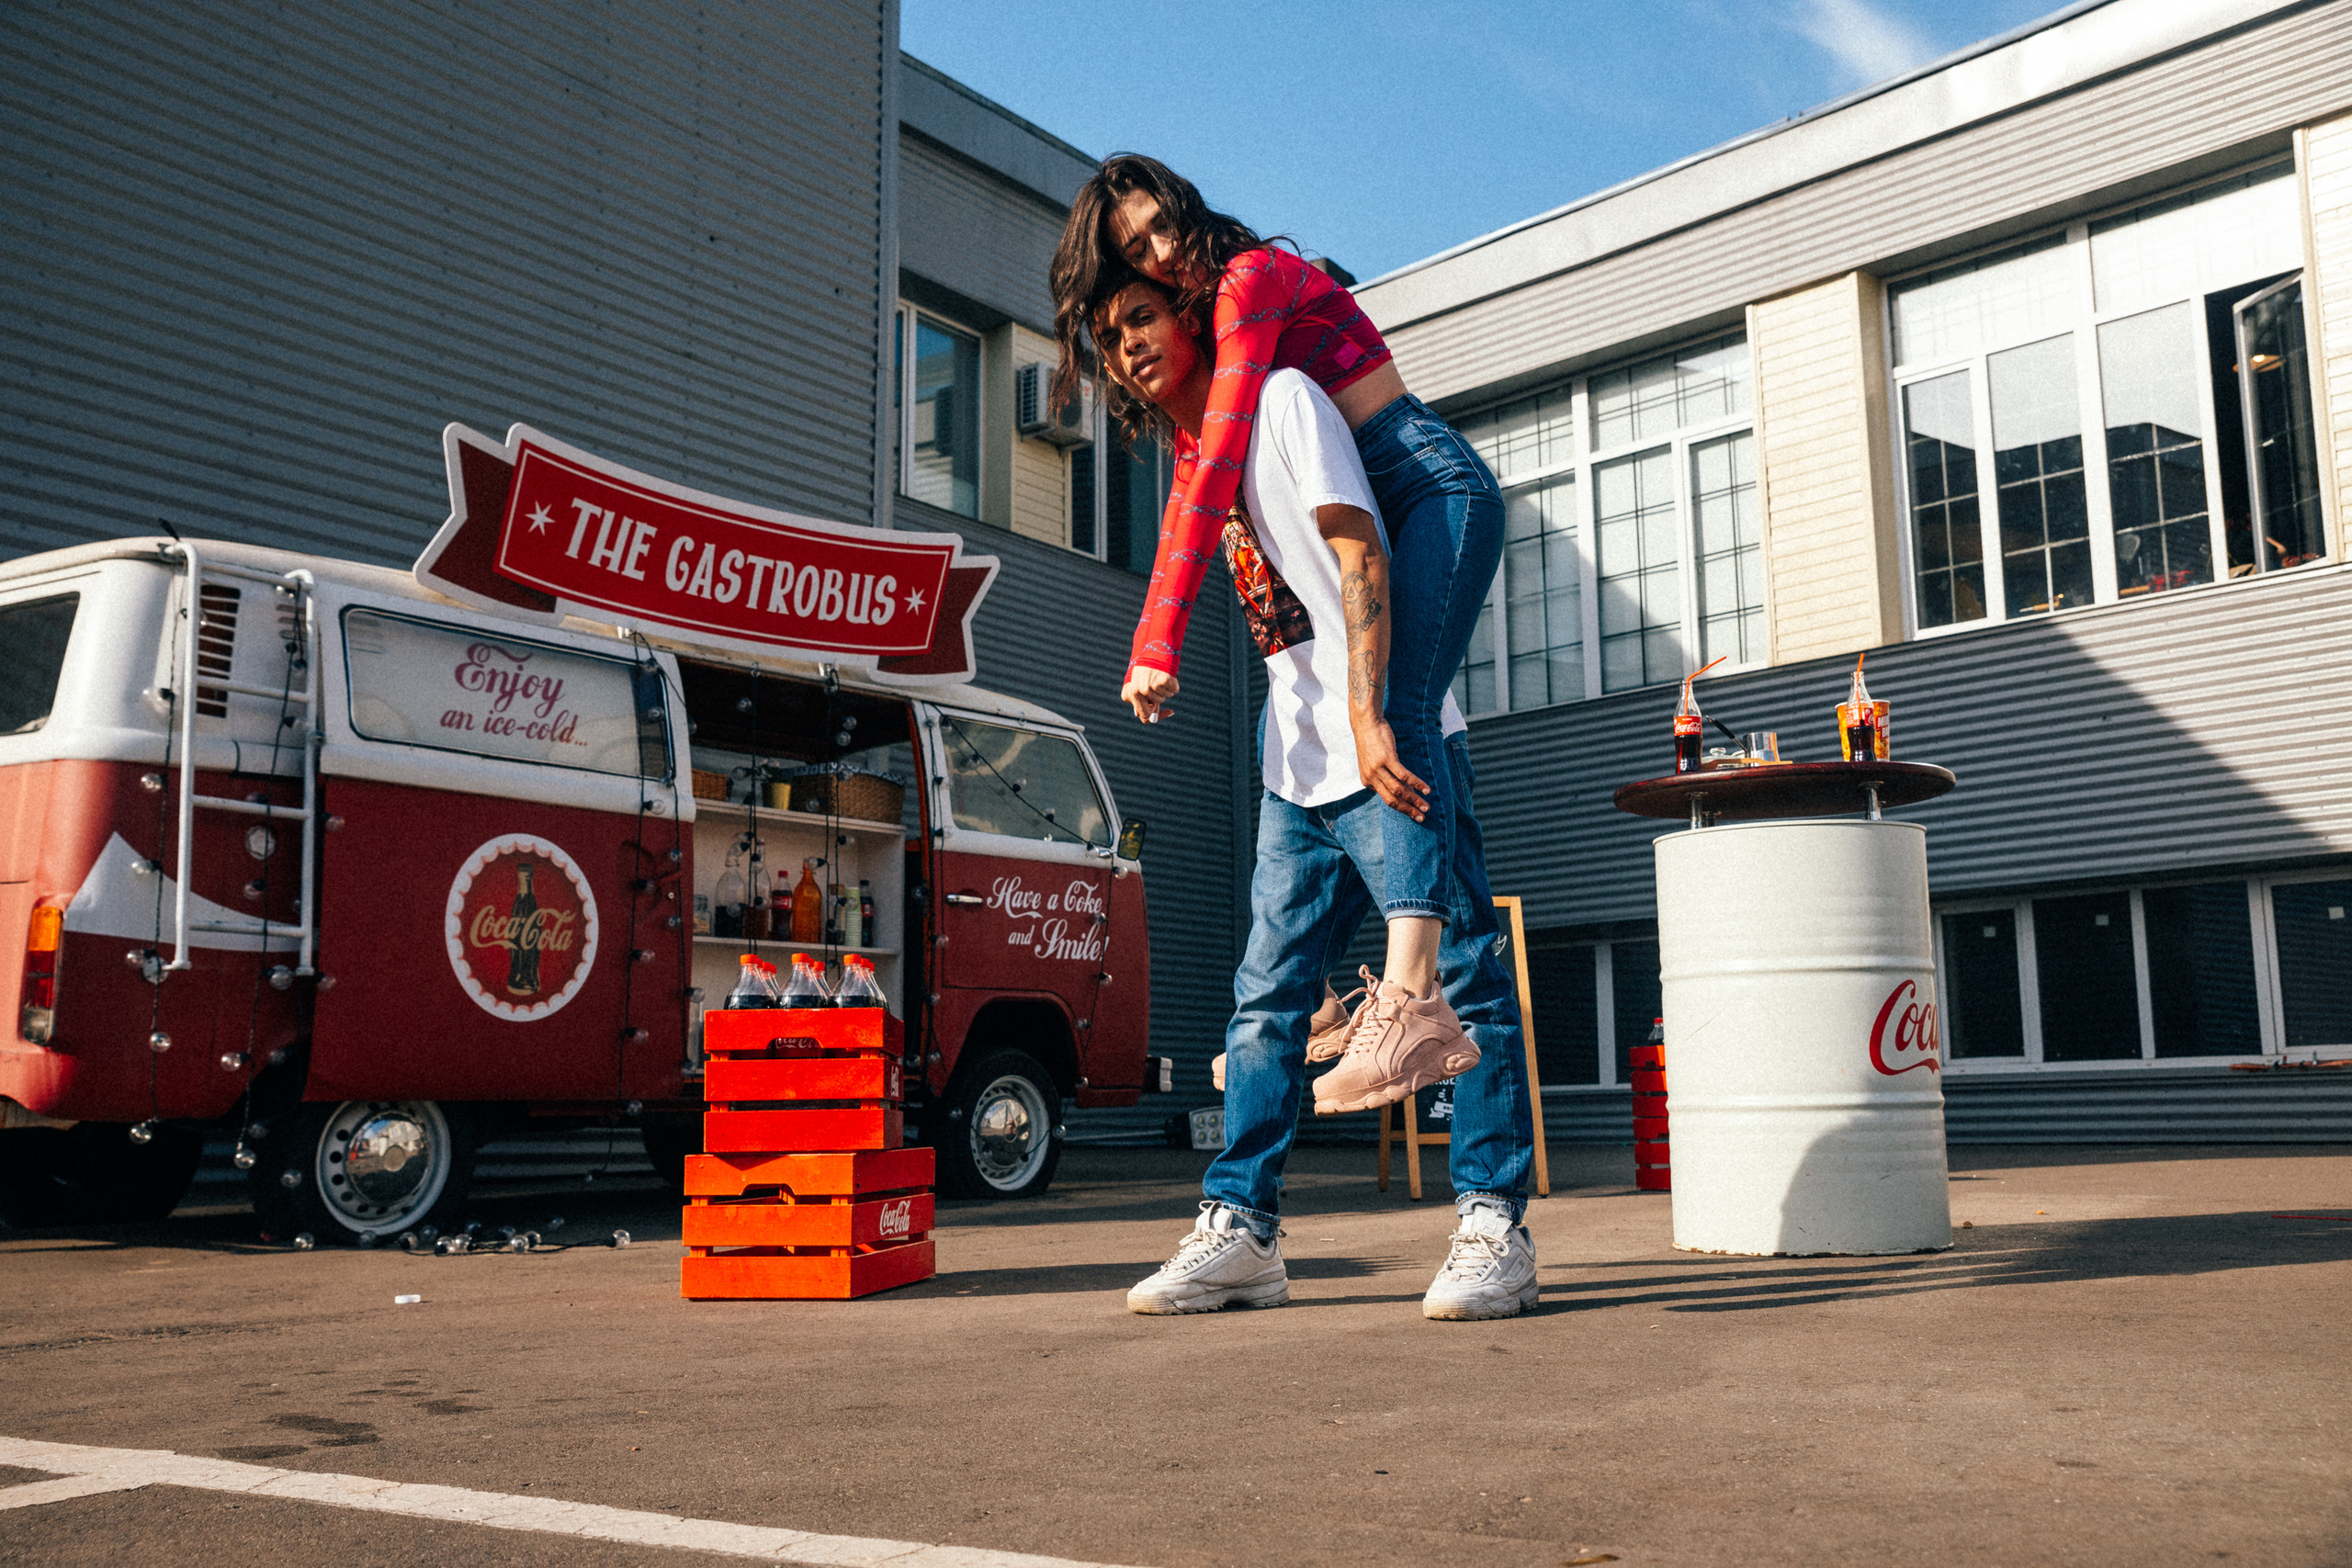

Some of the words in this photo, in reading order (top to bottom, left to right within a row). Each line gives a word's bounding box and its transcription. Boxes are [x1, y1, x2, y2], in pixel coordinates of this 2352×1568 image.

[564, 497, 658, 581] THE
[665, 536, 897, 626] GASTROBUS
[454, 642, 565, 718] Enjoy
[439, 709, 474, 730] an
[483, 709, 588, 746] ice-cold...
[987, 876, 1044, 919] Have
[1046, 894, 1058, 910] a
[1064, 880, 1102, 915] Coke
[1008, 924, 1035, 945] and
[1035, 918, 1110, 962] Smile!
